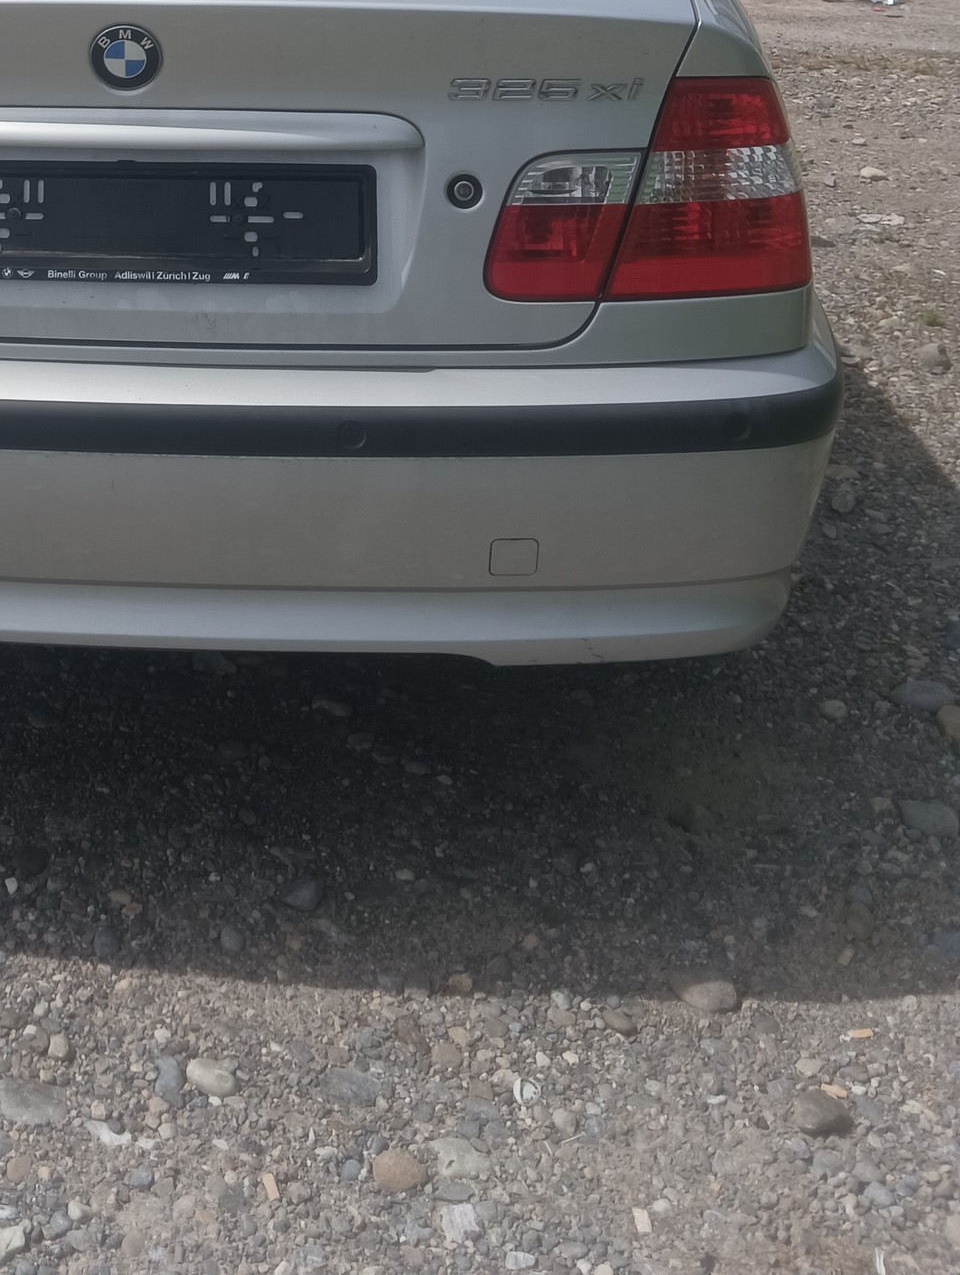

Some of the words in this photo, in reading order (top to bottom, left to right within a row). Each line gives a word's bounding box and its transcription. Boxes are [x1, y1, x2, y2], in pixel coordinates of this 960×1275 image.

[97, 29, 154, 50] BMW
[47, 270, 76, 279] Binelli
[78, 270, 108, 281] Group
